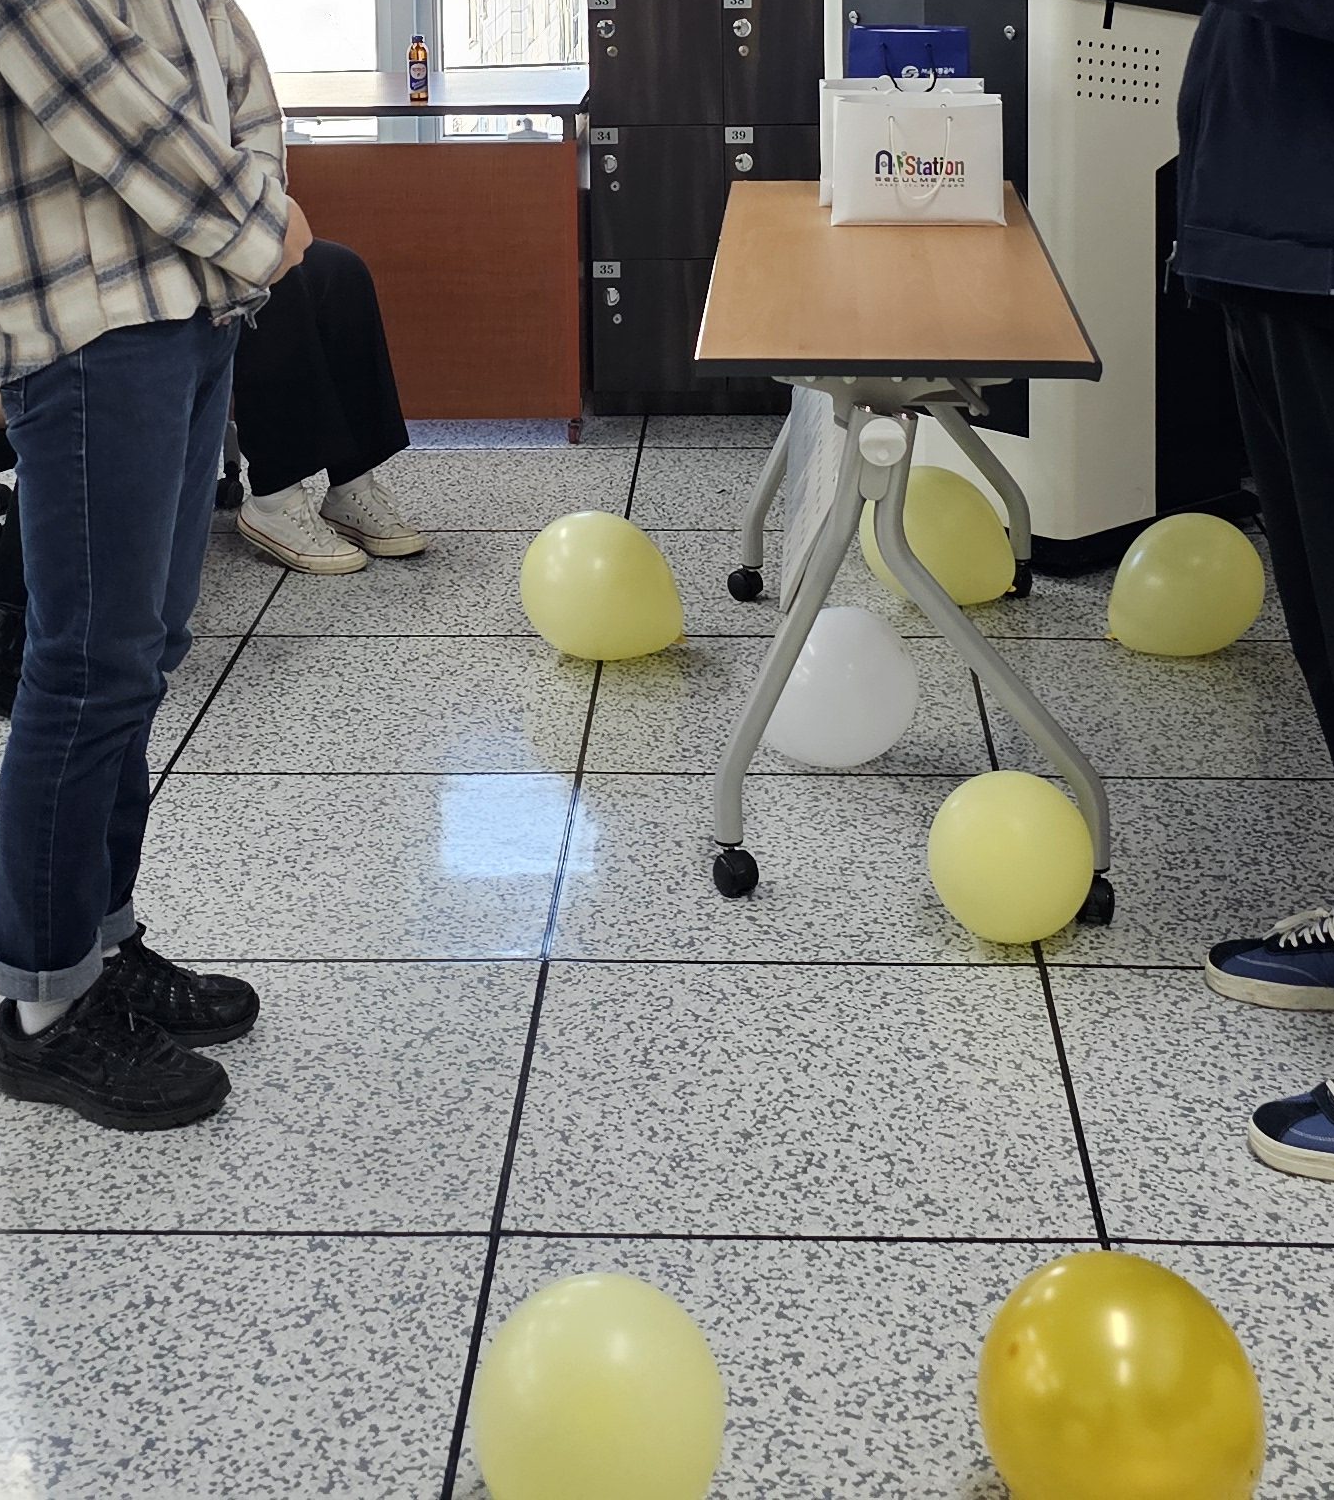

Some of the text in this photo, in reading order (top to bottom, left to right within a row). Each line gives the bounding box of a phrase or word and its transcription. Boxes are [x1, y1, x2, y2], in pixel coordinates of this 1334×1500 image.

[597, 131, 612, 141] 34
[731, 130, 746, 140] 39
[599, 264, 614, 275] 35
